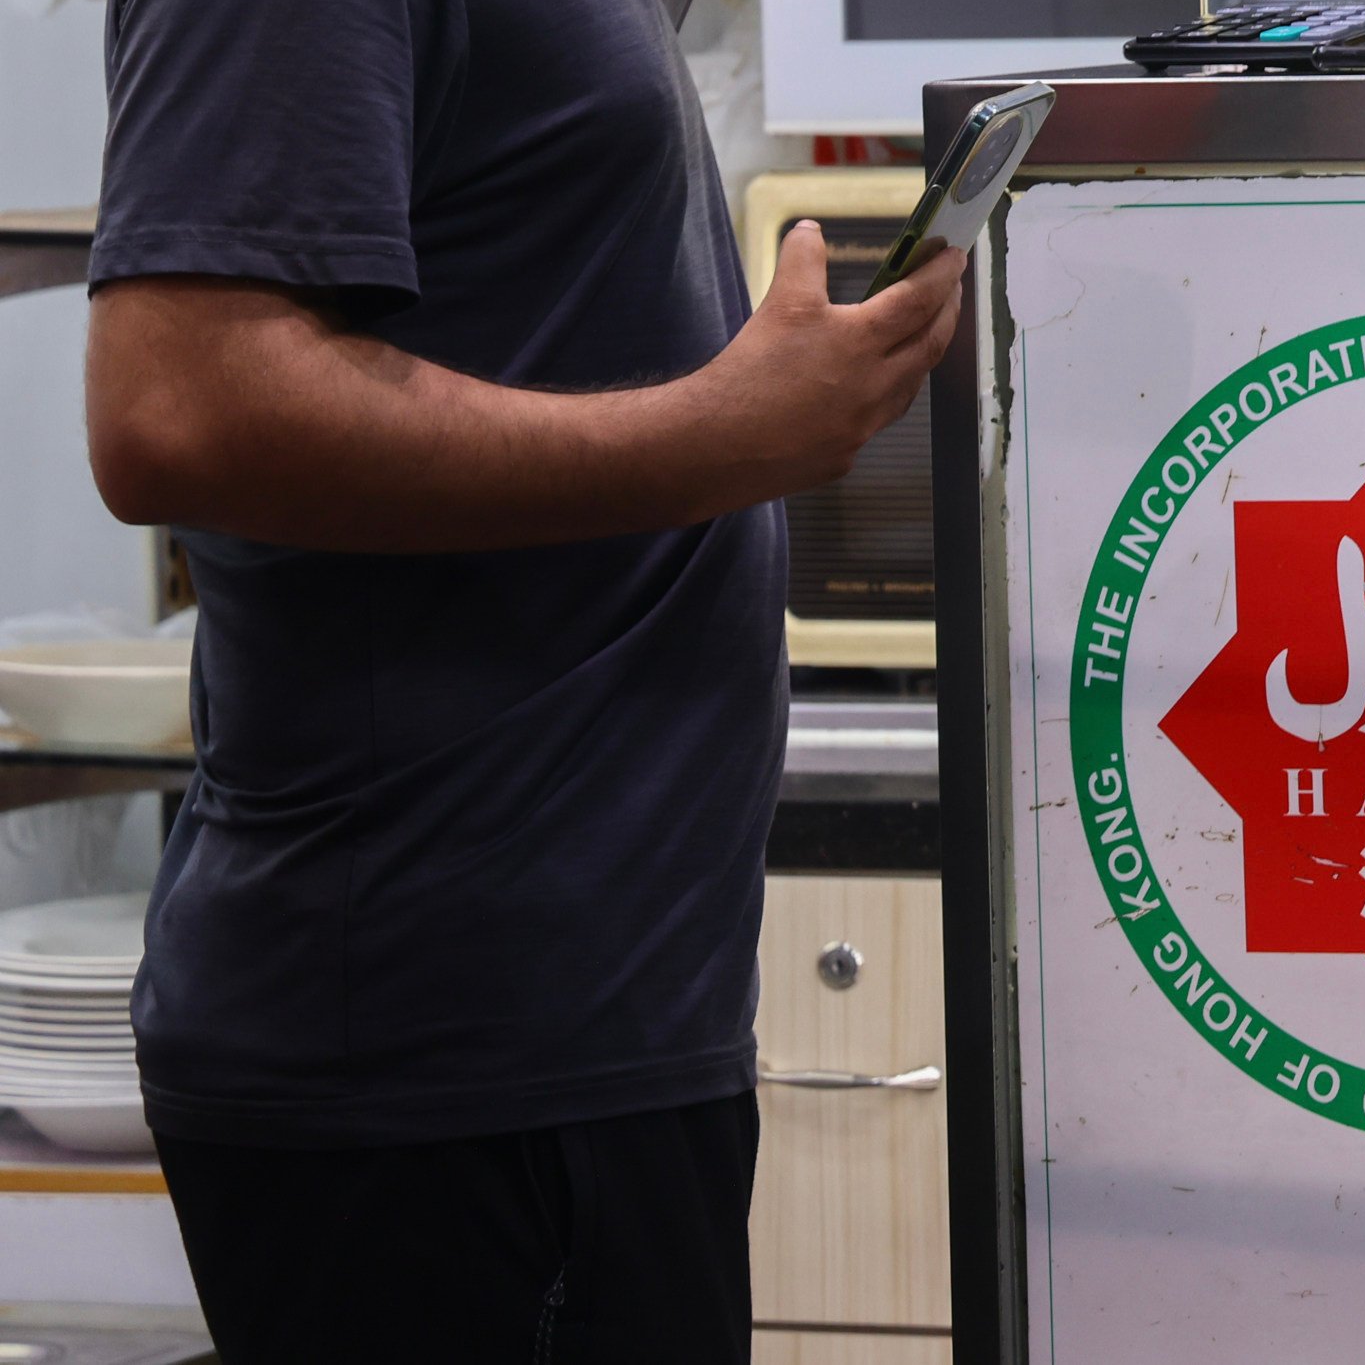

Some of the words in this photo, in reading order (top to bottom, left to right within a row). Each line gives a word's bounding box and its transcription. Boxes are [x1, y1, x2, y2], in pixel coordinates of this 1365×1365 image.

[1083, 586, 1134, 689] THE
[1087, 751, 1160, 924] KONG.
[1152, 934, 1269, 1062] HONG
[1277, 1058, 1342, 1106] OF
